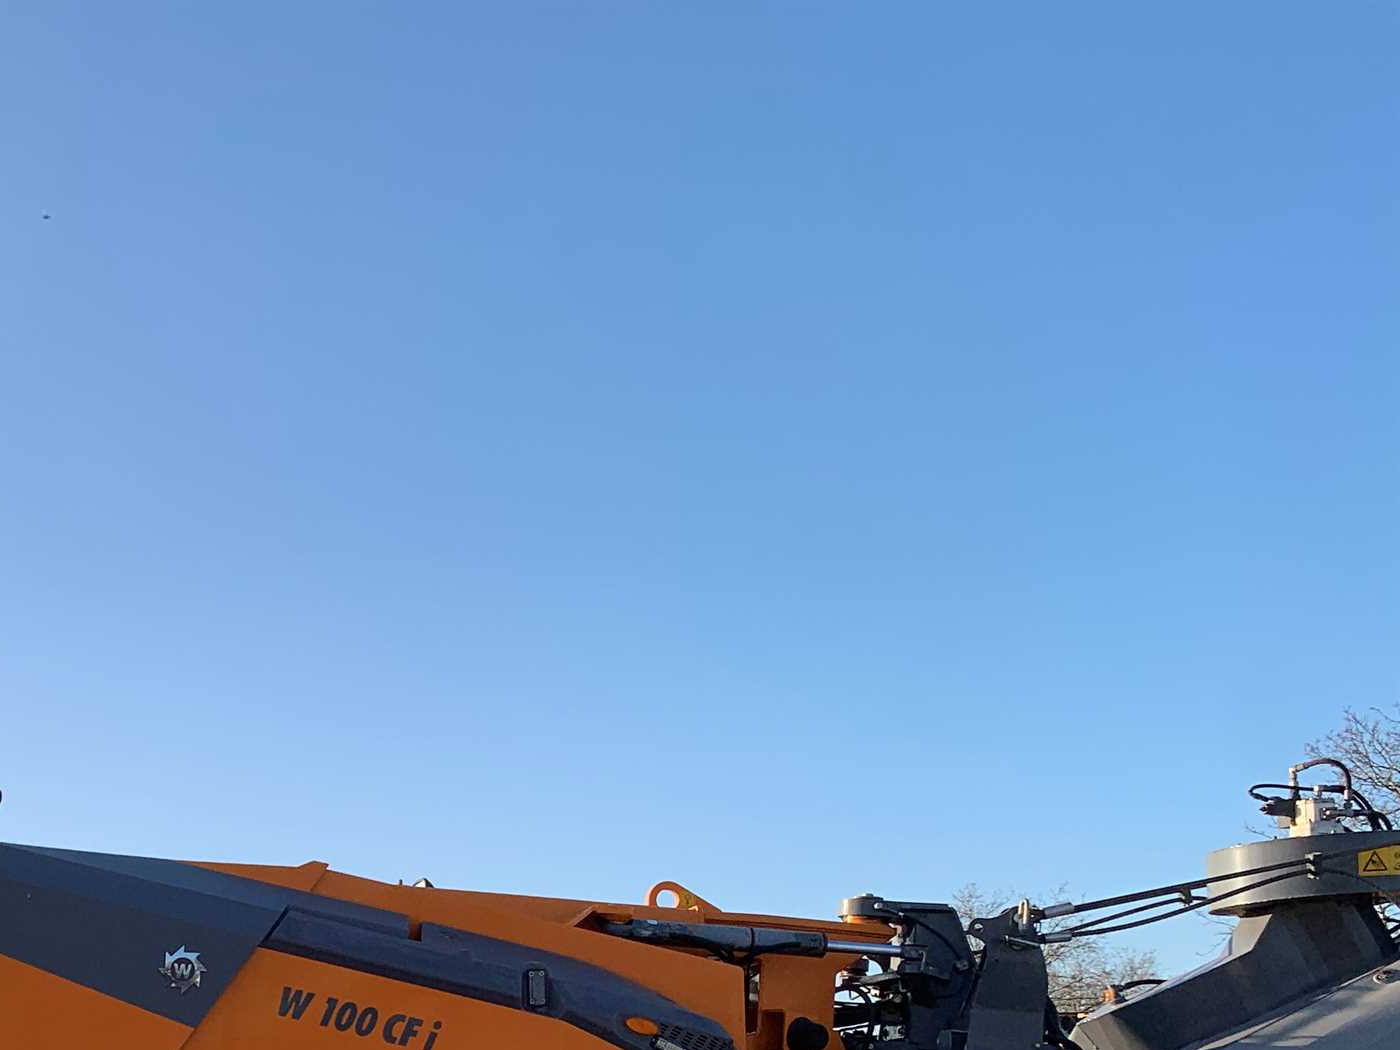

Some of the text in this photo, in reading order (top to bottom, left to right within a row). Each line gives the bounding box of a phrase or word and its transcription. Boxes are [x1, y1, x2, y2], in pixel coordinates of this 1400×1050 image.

[173, 962, 193, 978] W
[278, 985, 316, 1021] W
[319, 996, 378, 1037] 100
